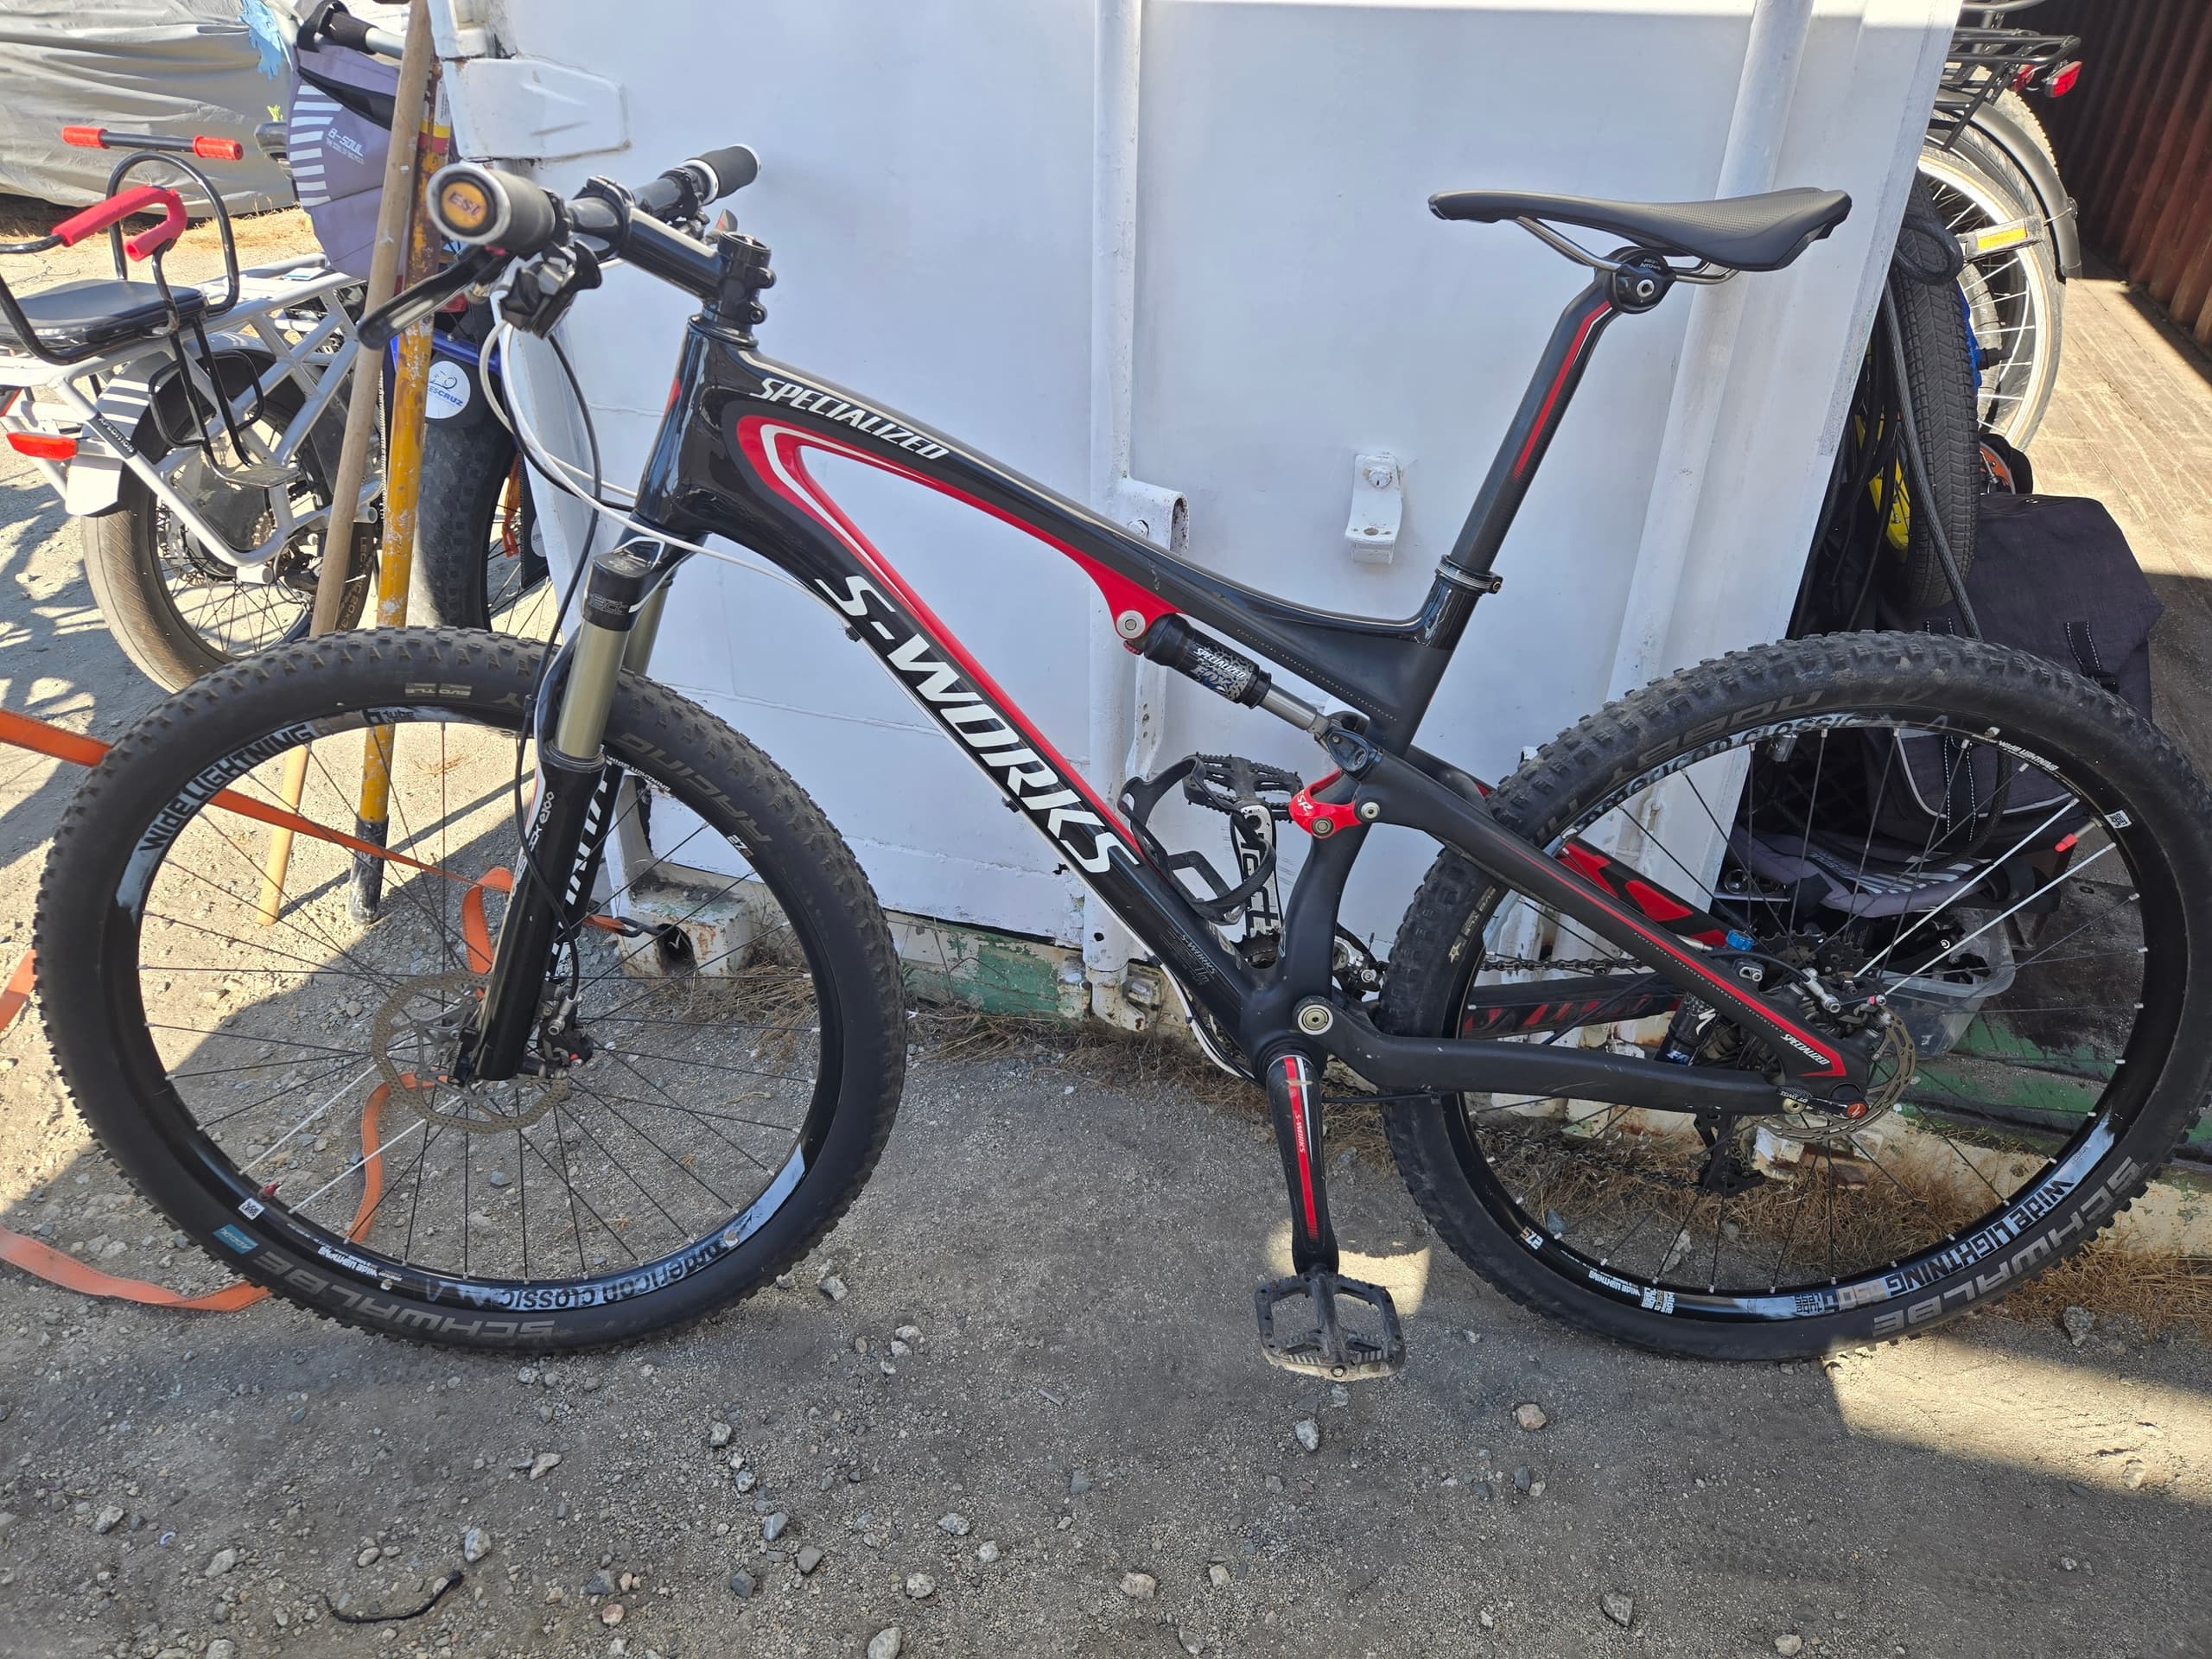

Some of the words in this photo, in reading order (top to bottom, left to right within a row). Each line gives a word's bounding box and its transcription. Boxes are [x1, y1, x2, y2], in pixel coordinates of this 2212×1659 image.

[327, 128, 364, 157] B-SOUL
[749, 377, 950, 460] SPECIALIZED
[1191, 665, 1235, 690] FOX
[1192, 647, 1247, 679] SPECIALIZED
[185, 722, 314, 800] LIGHTNING
[815, 575, 1140, 873] S-WORKS
[614, 732, 772, 842] RACING
[1181, 935, 1216, 975] S-WORKS
[1782, 1033, 1830, 1066] SPECIALIZED
[1294, 1114, 1306, 1154] S-WORKS
[1872, 1156, 2143, 1337] SCHWALBE
[1885, 1215, 2016, 1297] LIGHTNING
[253, 1251, 556, 1338] SCHWALBE
